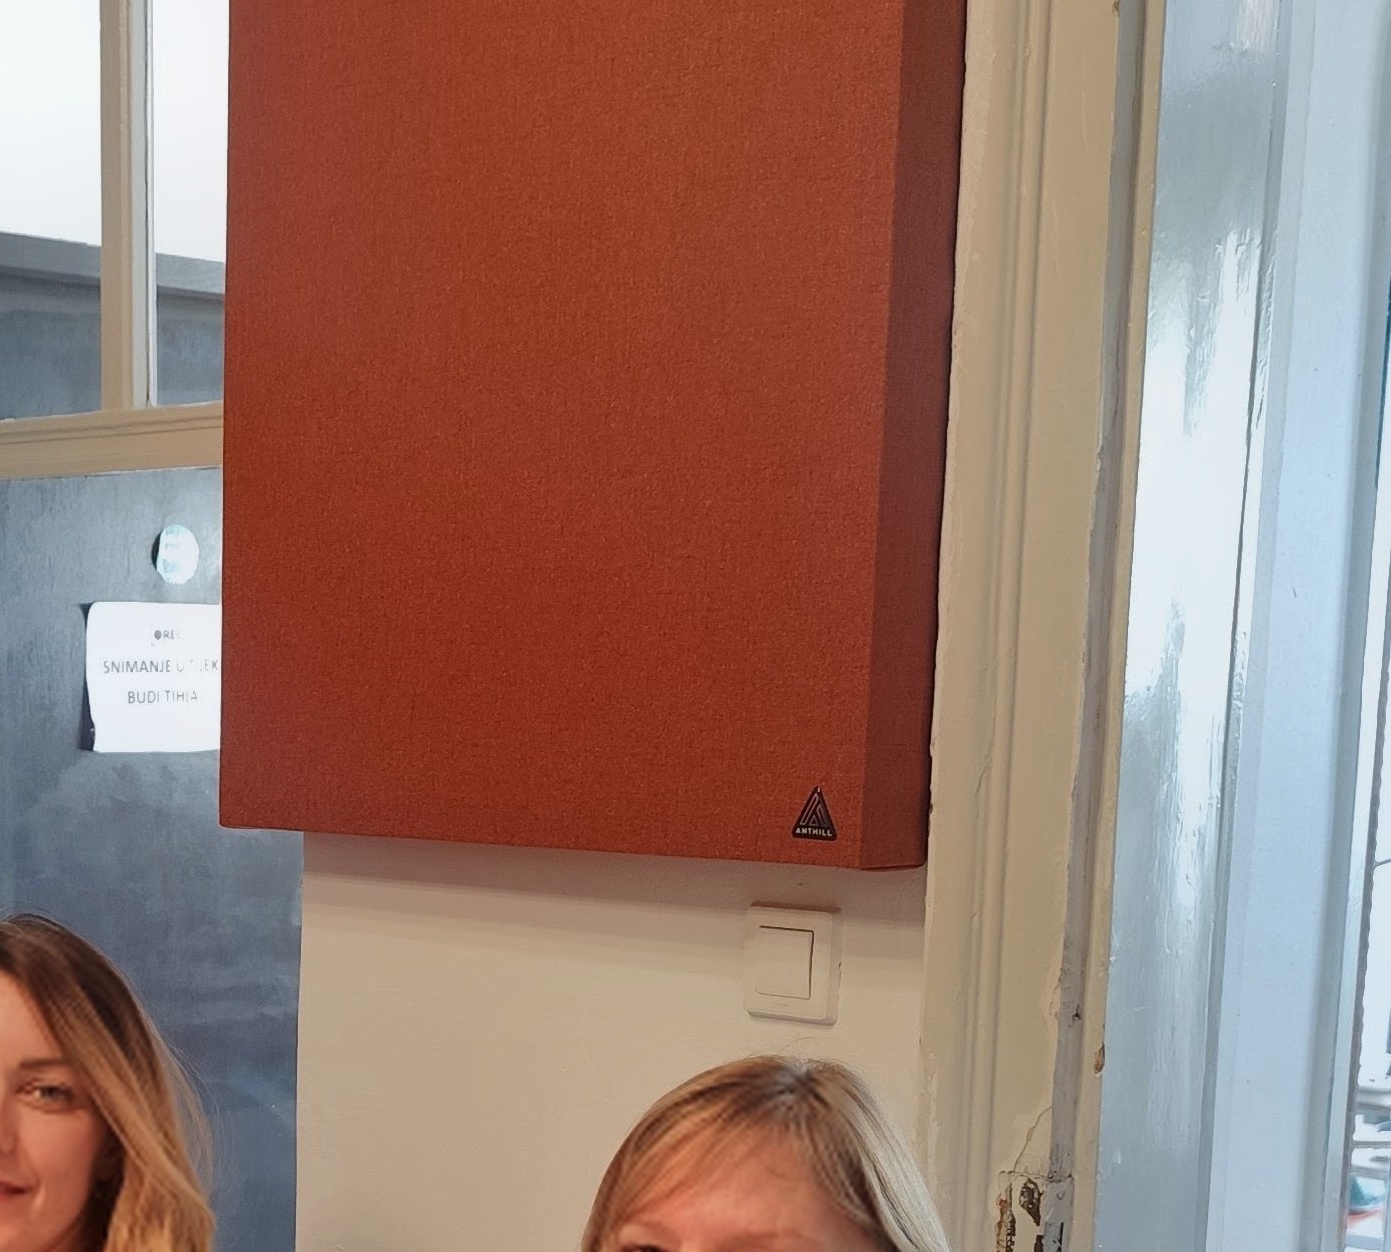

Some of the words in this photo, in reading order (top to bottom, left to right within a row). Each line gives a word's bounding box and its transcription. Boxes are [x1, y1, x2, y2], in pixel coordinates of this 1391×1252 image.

[103, 659, 171, 674] SNIMANJE
[127, 690, 160, 704] BUDI
[795, 827, 833, 837] ANTHILL
